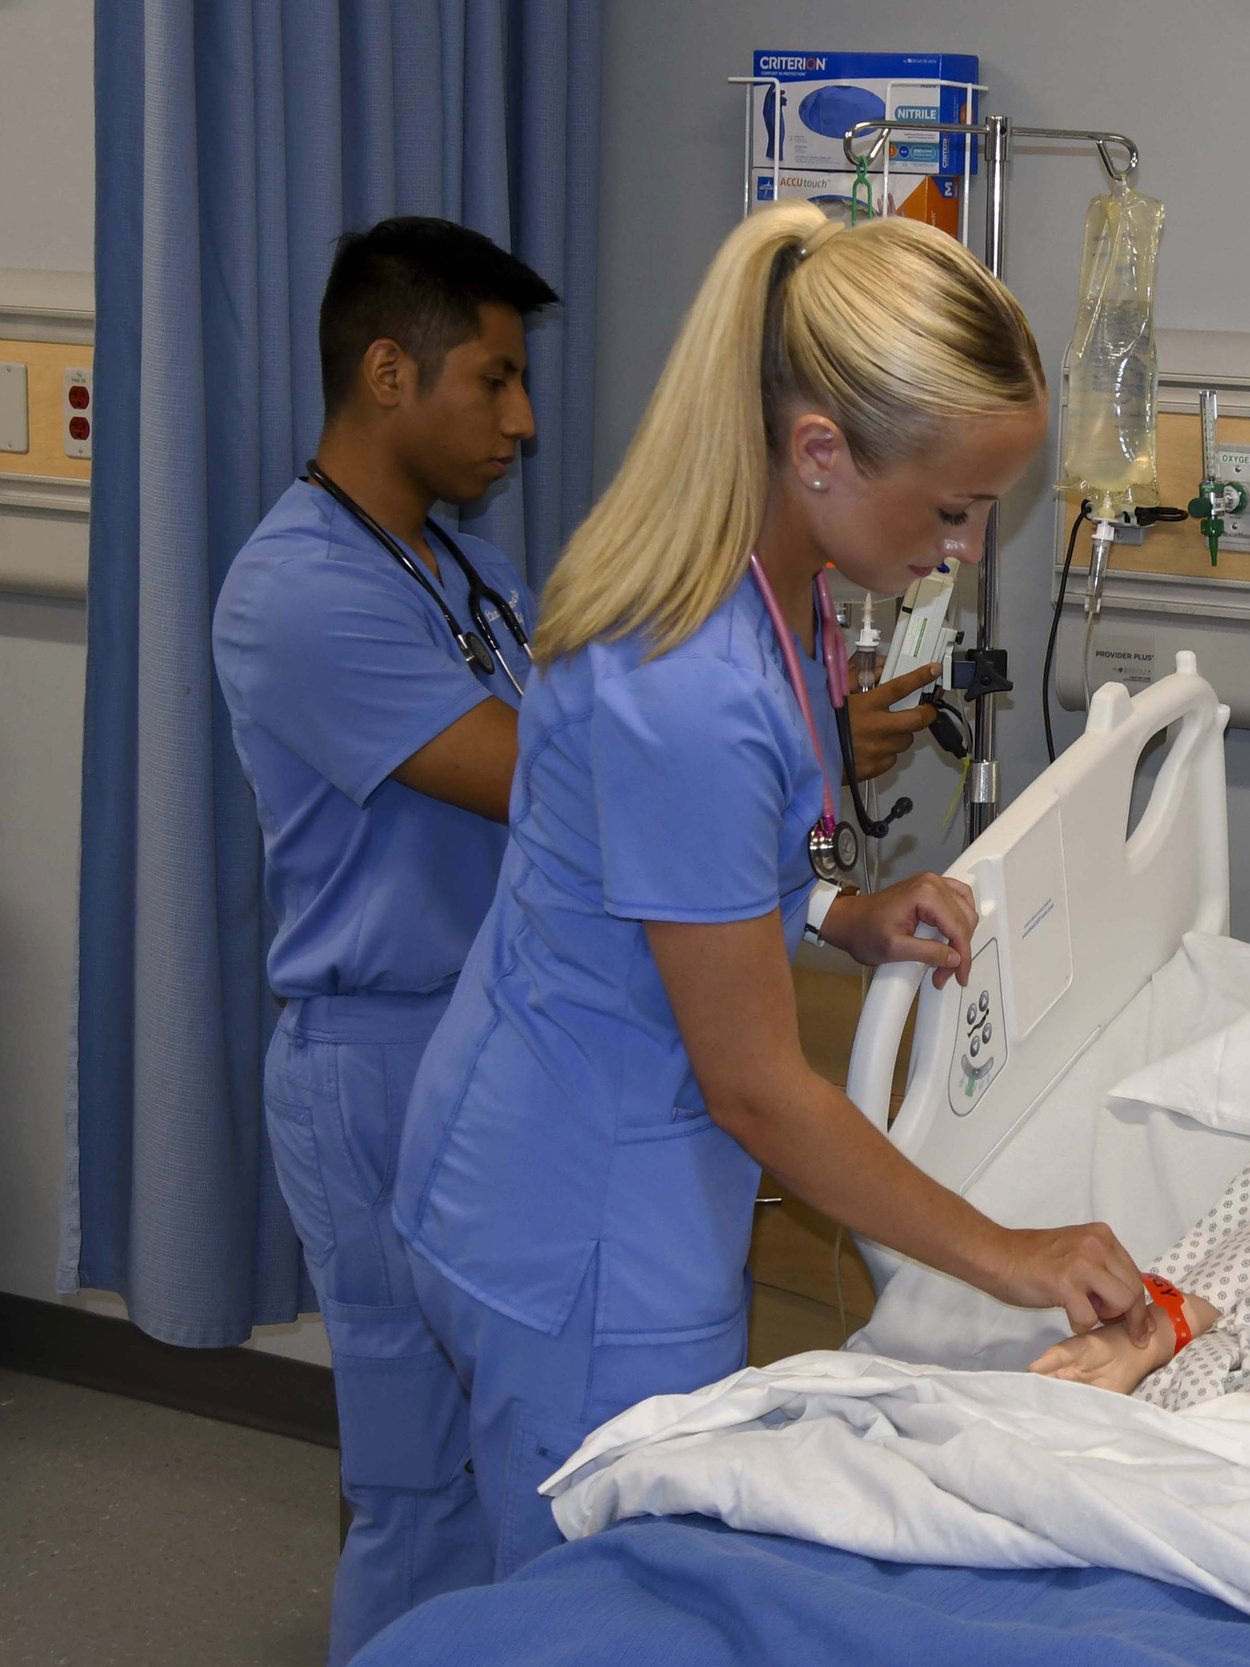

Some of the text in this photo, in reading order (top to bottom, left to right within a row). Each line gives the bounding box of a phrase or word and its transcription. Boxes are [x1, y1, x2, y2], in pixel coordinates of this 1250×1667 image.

[760, 56, 827, 71] CRITERION
[897, 108, 937, 120] NITRILE
[944, 182, 953, 196] M
[1095, 650, 1152, 661] PROVIDER PLUS
